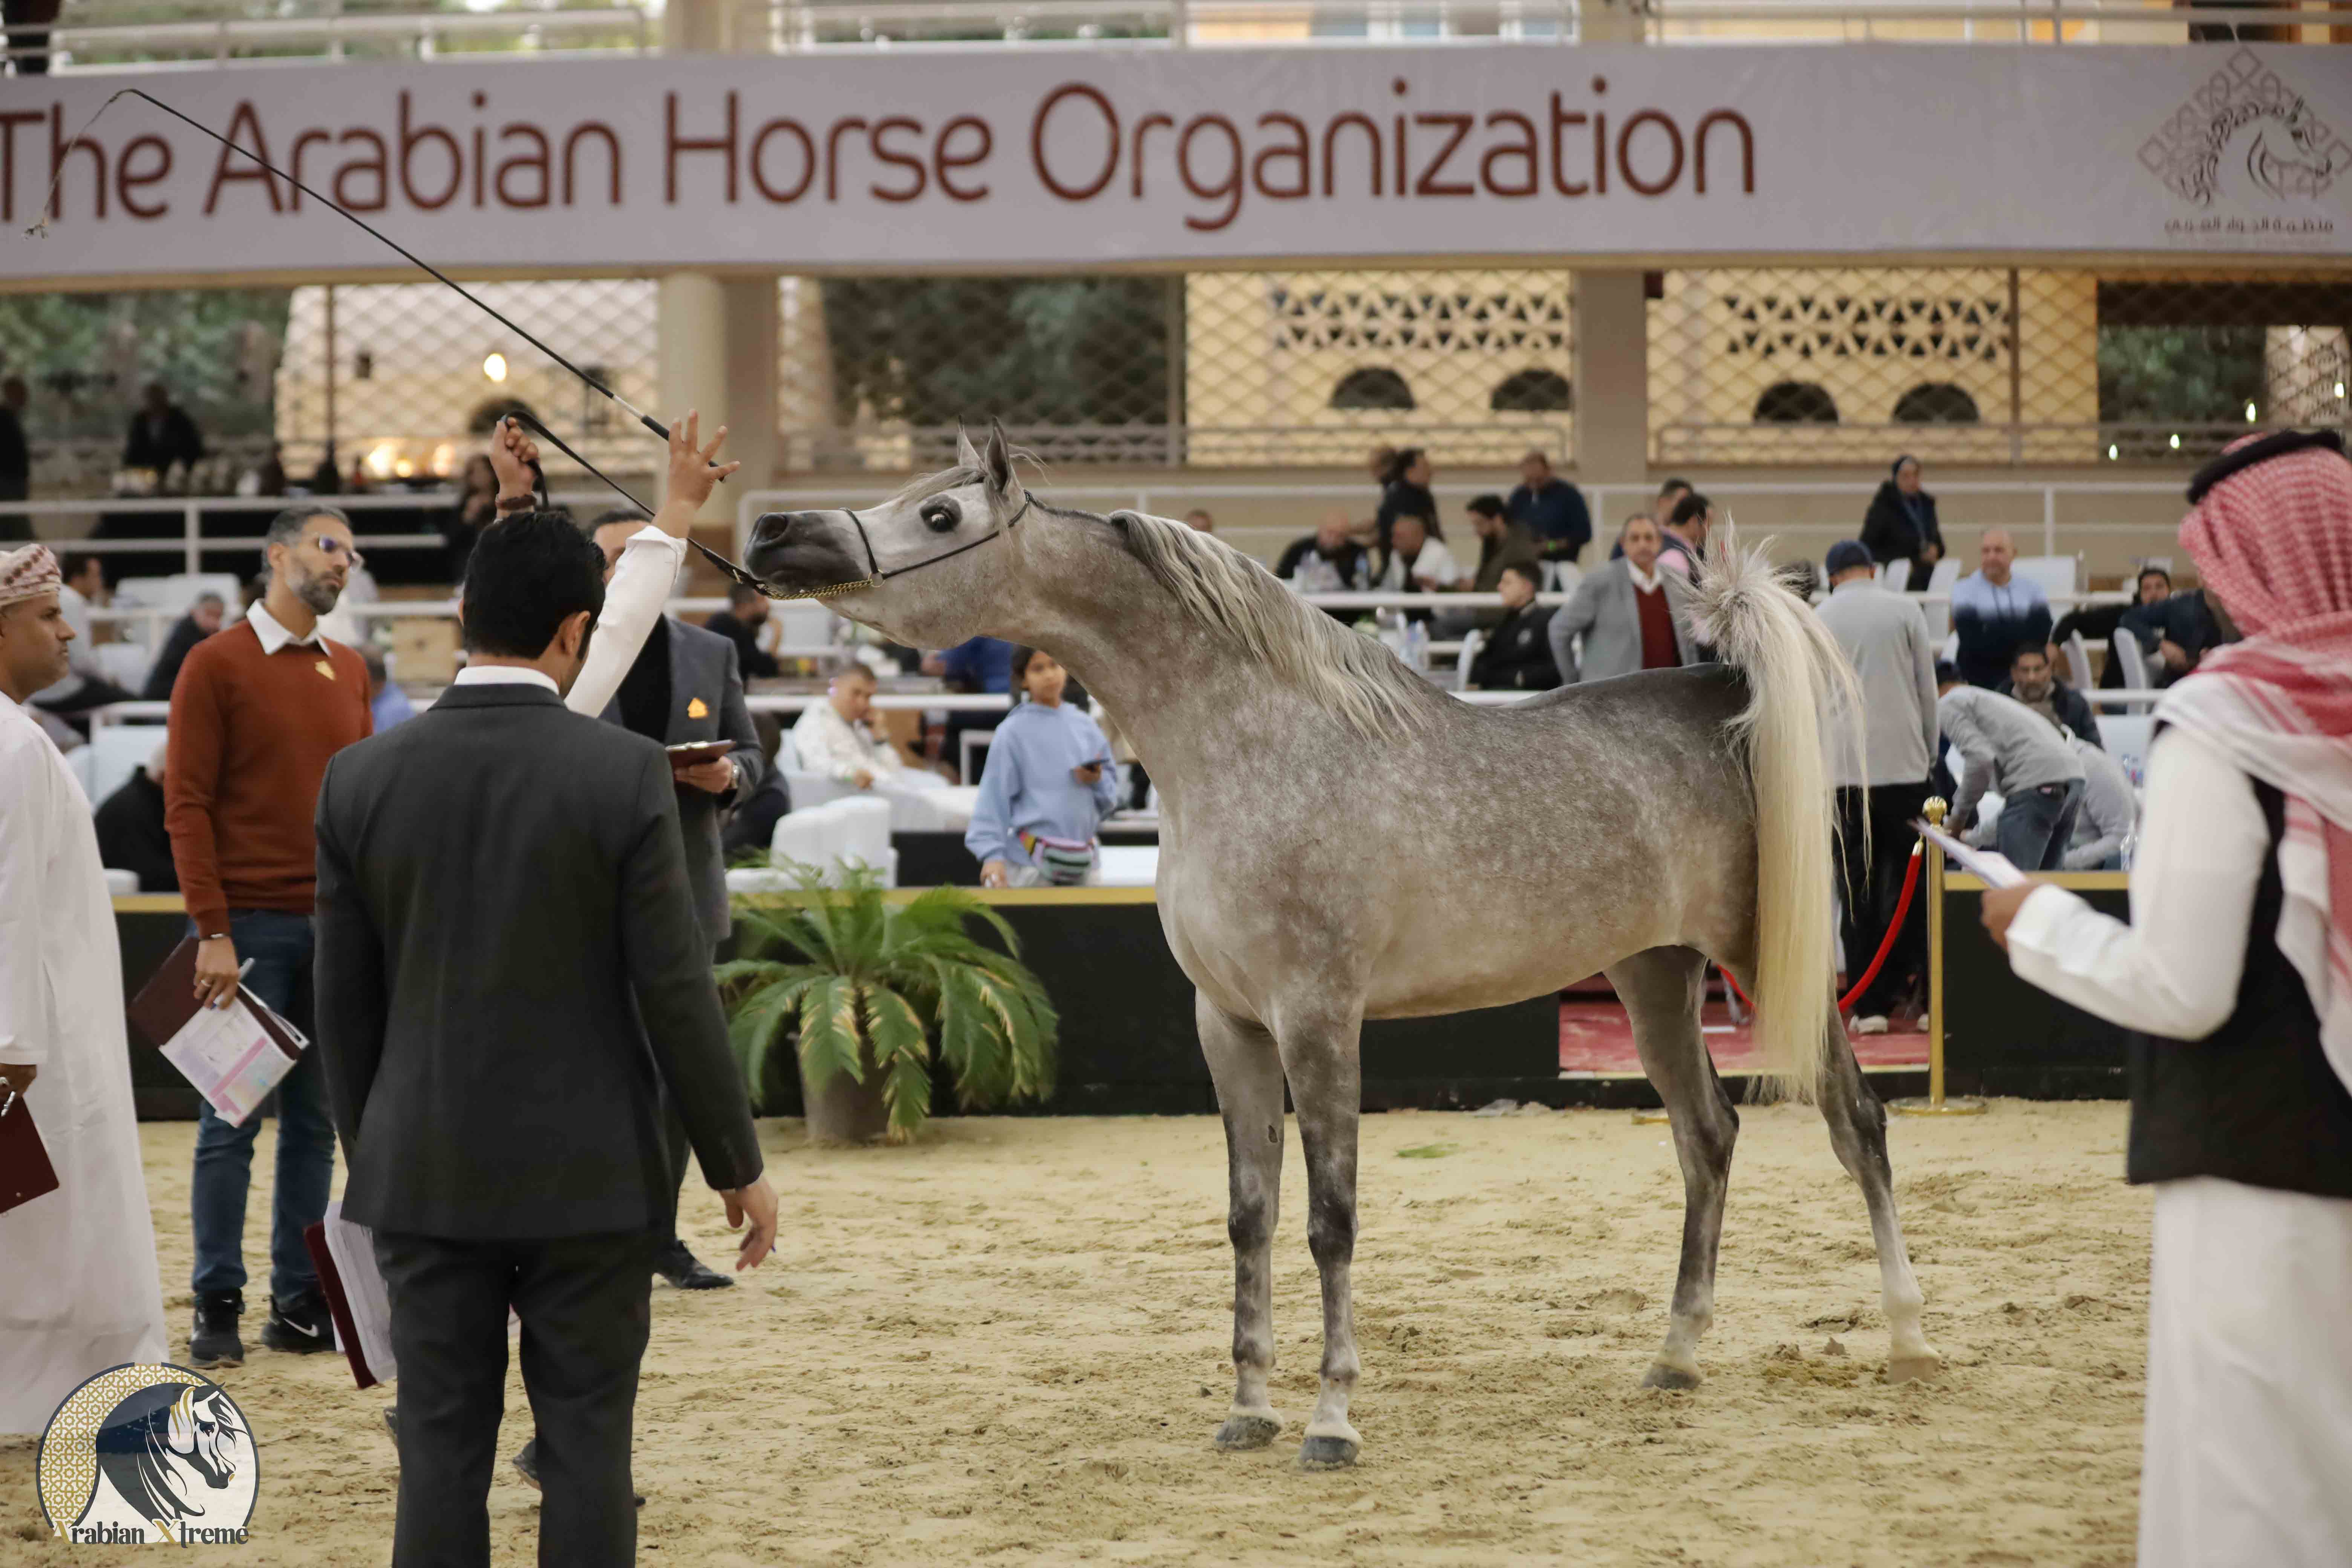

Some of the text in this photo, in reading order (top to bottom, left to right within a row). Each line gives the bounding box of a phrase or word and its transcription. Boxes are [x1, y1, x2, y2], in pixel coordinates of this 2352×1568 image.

[0, 76, 1755, 233] The Arabian Horse Organization
